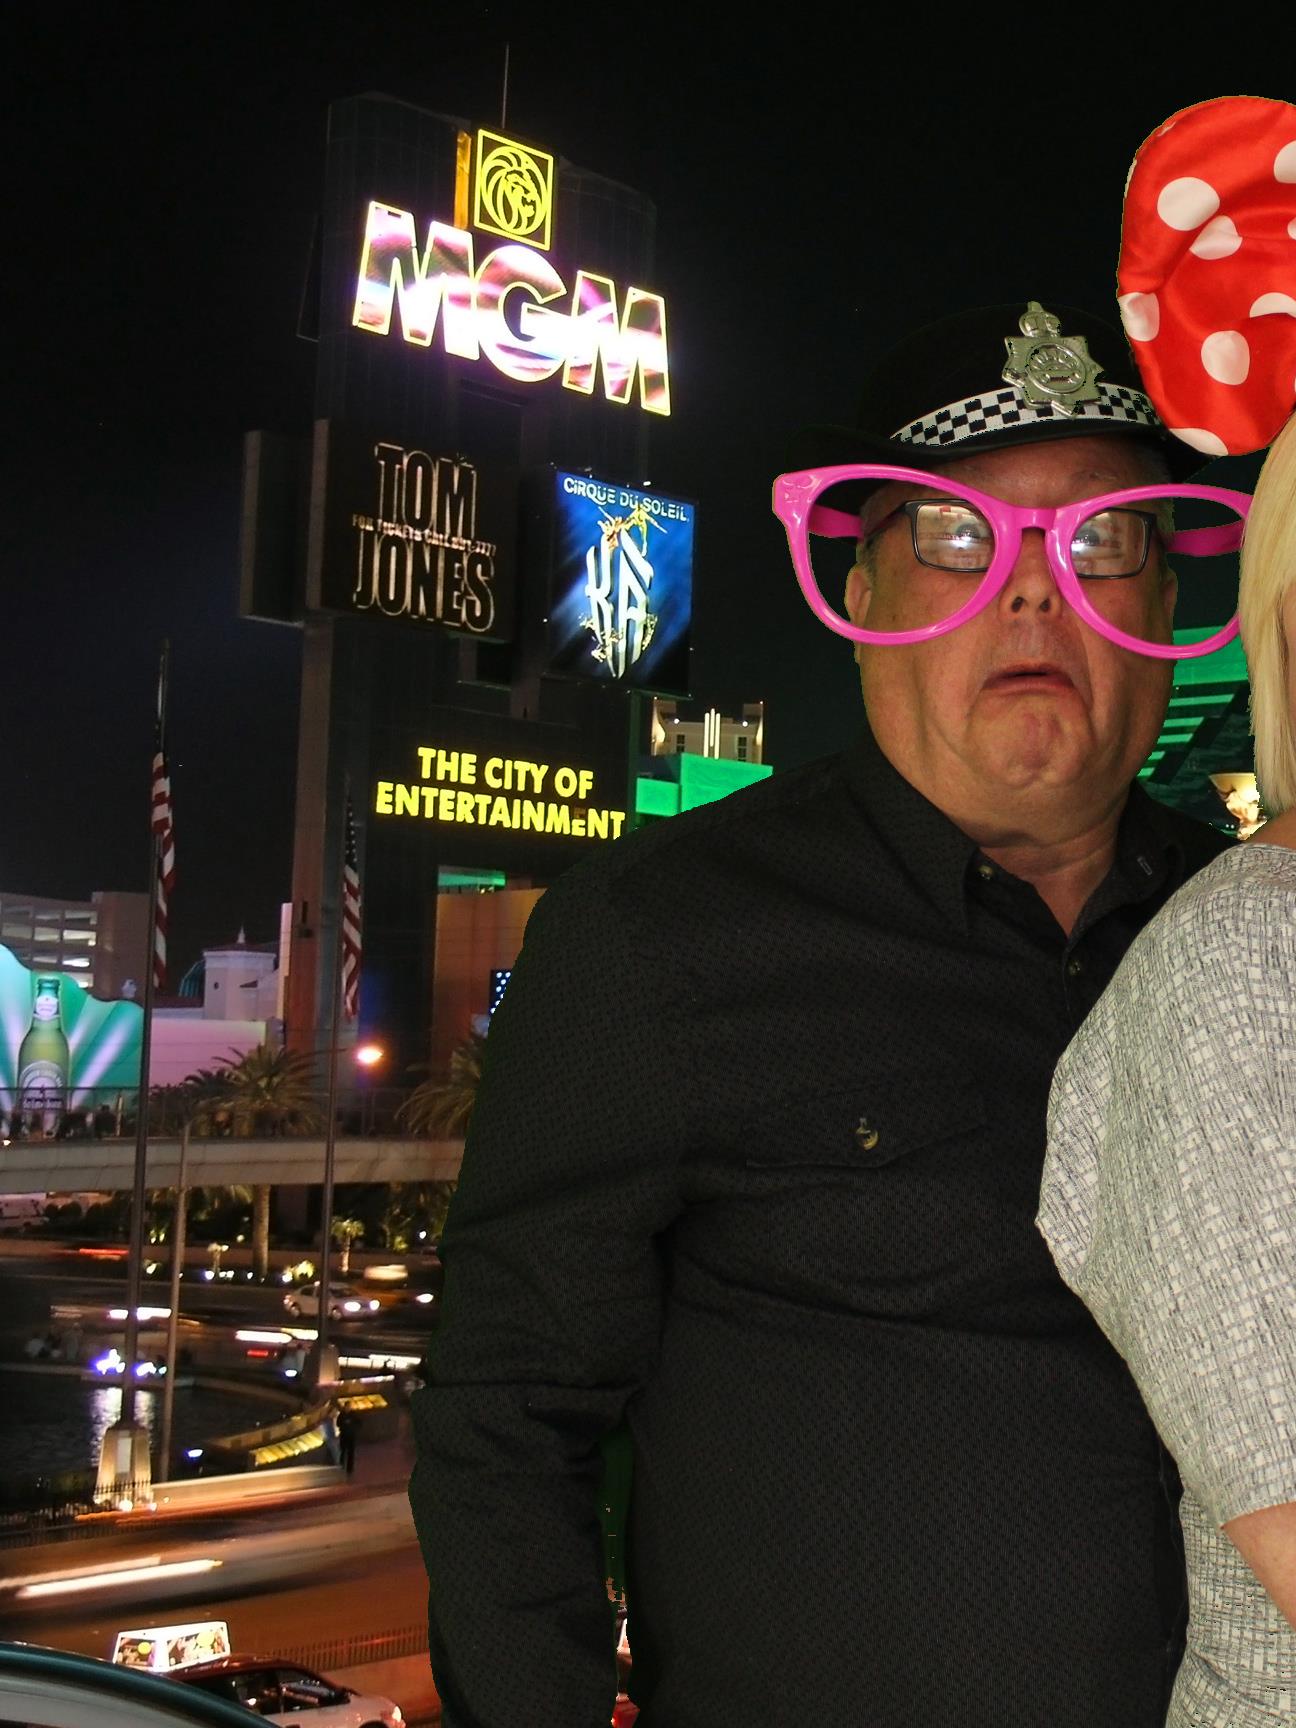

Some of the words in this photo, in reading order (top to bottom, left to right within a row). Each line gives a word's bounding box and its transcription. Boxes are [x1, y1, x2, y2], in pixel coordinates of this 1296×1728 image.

[352, 200, 671, 416] MGM
[374, 442, 477, 540] TOM
[563, 477, 617, 506] CIRQUE
[619, 491, 640, 510] DU
[352, 530, 495, 632] JONES
[375, 781, 626, 841] ENTERTAINMENT
[417, 746, 477, 785] THE
[484, 757, 549, 794] CITY
[554, 767, 594, 800] OF
